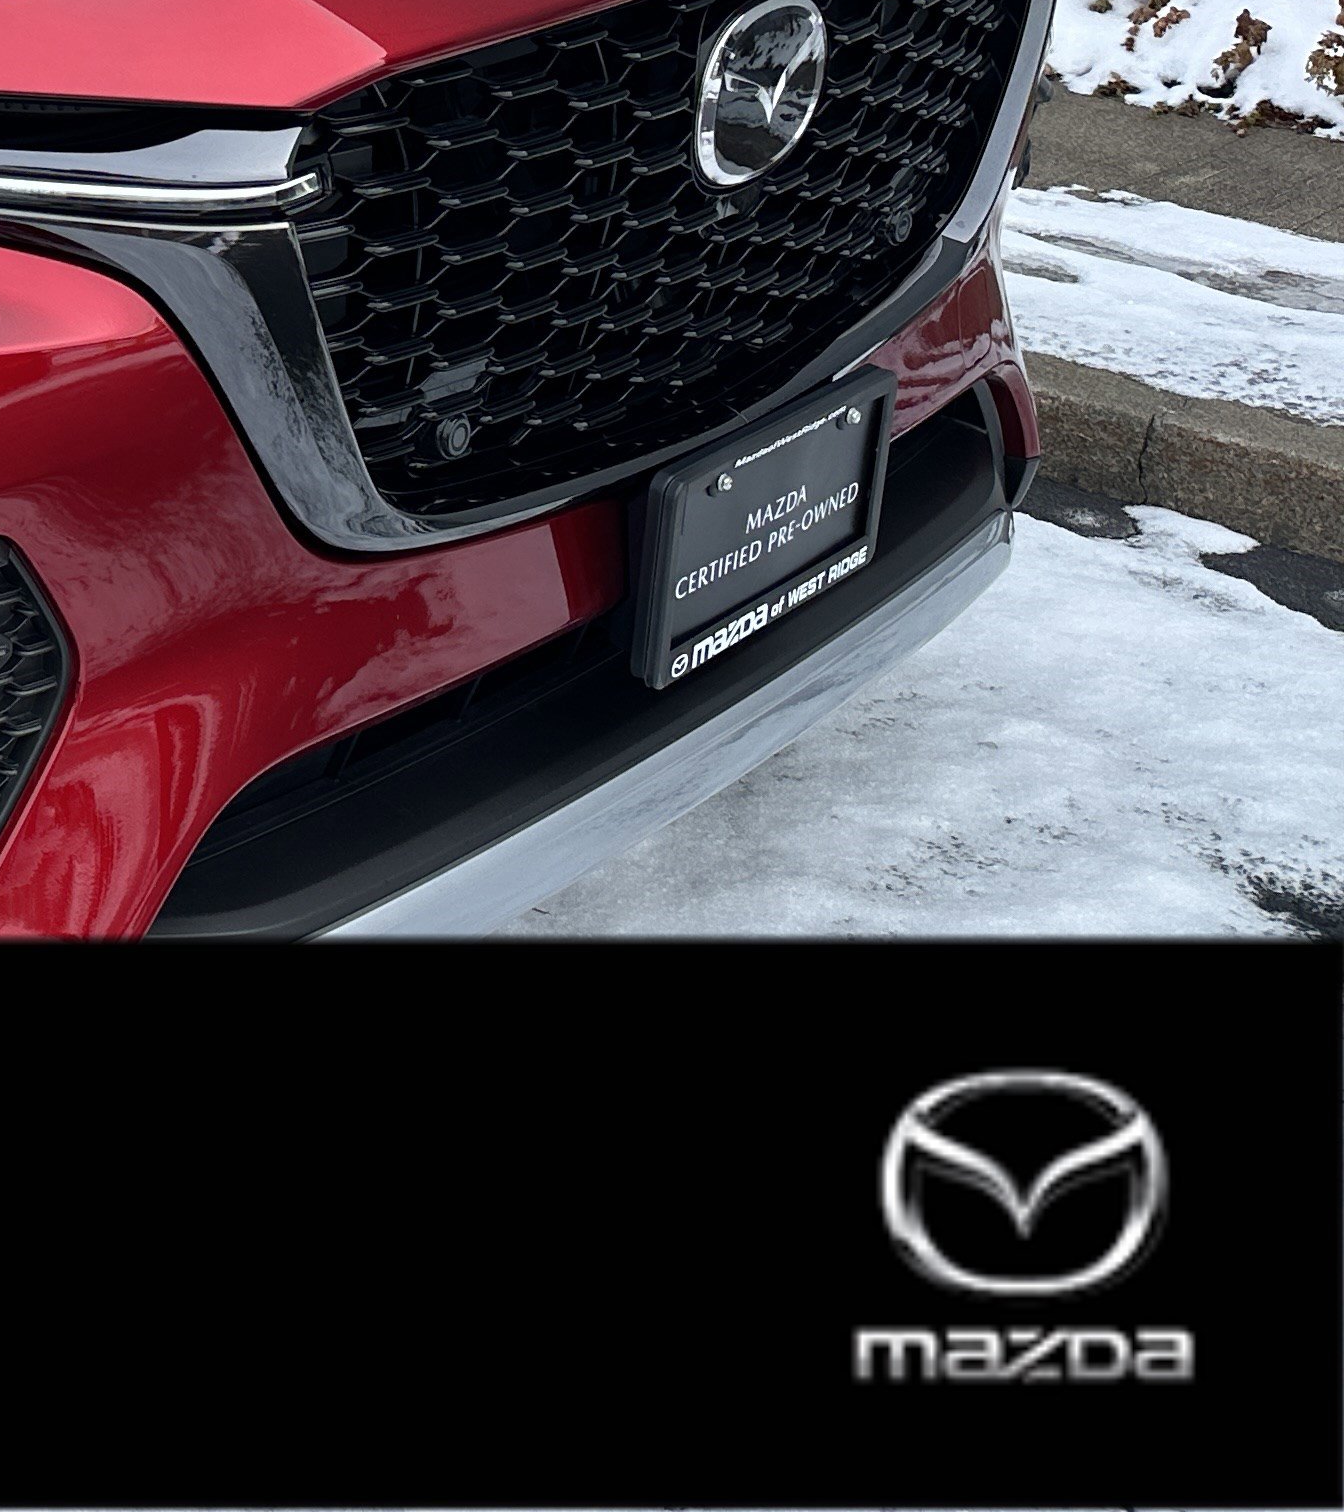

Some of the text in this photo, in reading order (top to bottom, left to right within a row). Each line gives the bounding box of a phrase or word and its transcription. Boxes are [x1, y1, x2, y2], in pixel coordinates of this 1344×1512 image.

[675, 481, 859, 600] CERTIFIED PRE-OWNED
[745, 484, 807, 534] MAZDA
[770, 595, 785, 617] of
[787, 572, 825, 608] WEST
[827, 545, 868, 584] RIDGE
